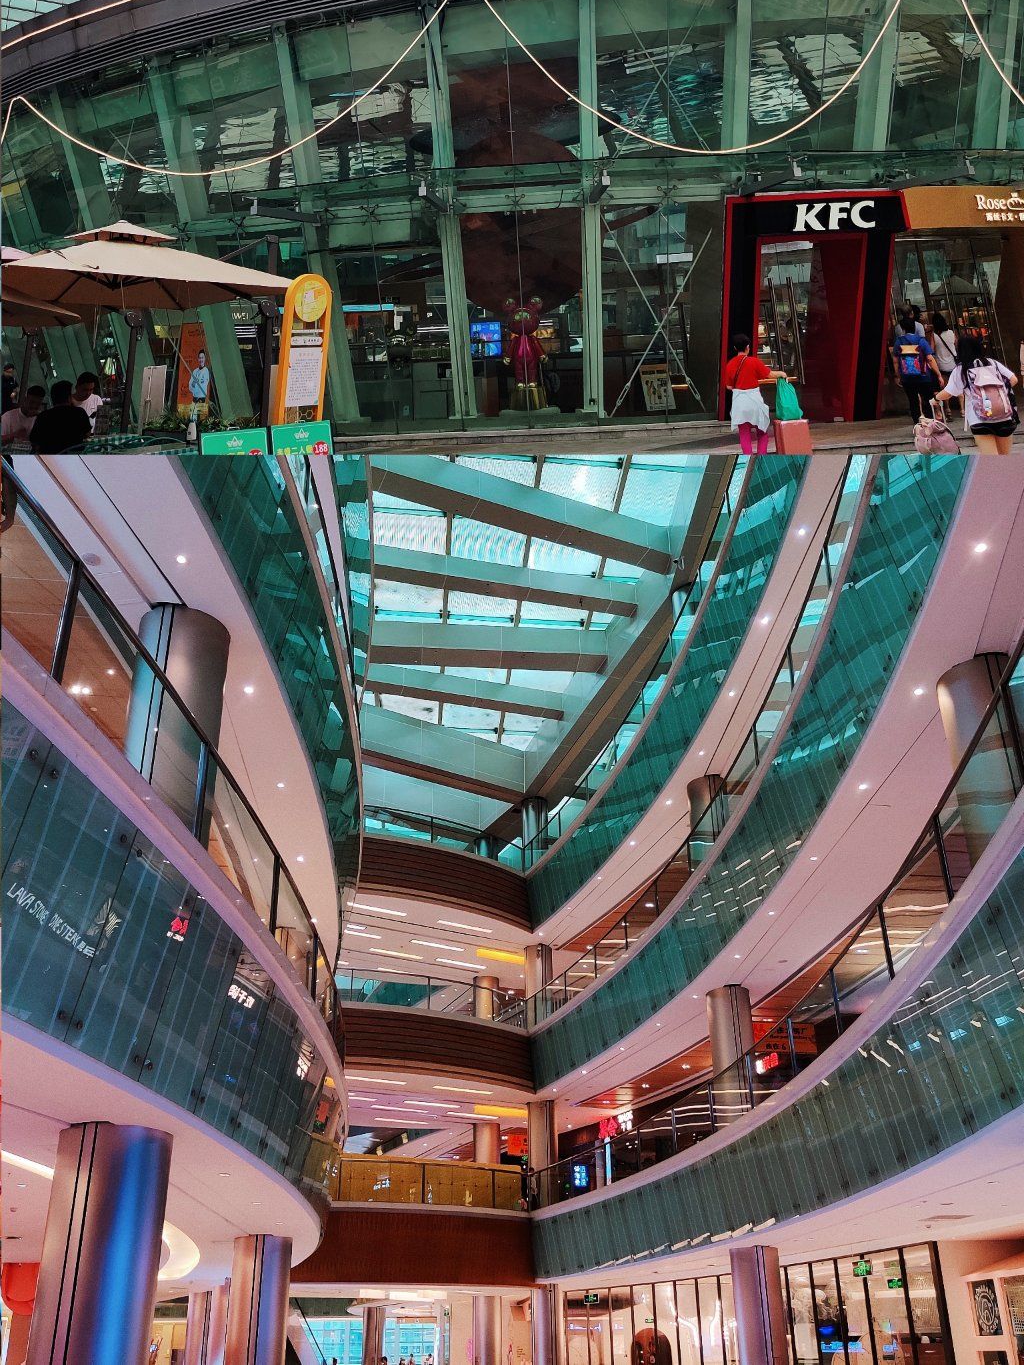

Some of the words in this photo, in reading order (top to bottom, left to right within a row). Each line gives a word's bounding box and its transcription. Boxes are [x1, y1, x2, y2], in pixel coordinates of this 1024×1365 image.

[792, 200, 876, 232] KFC
[975, 194, 1008, 210] Rose
[6, 882, 36, 910] LAVA
